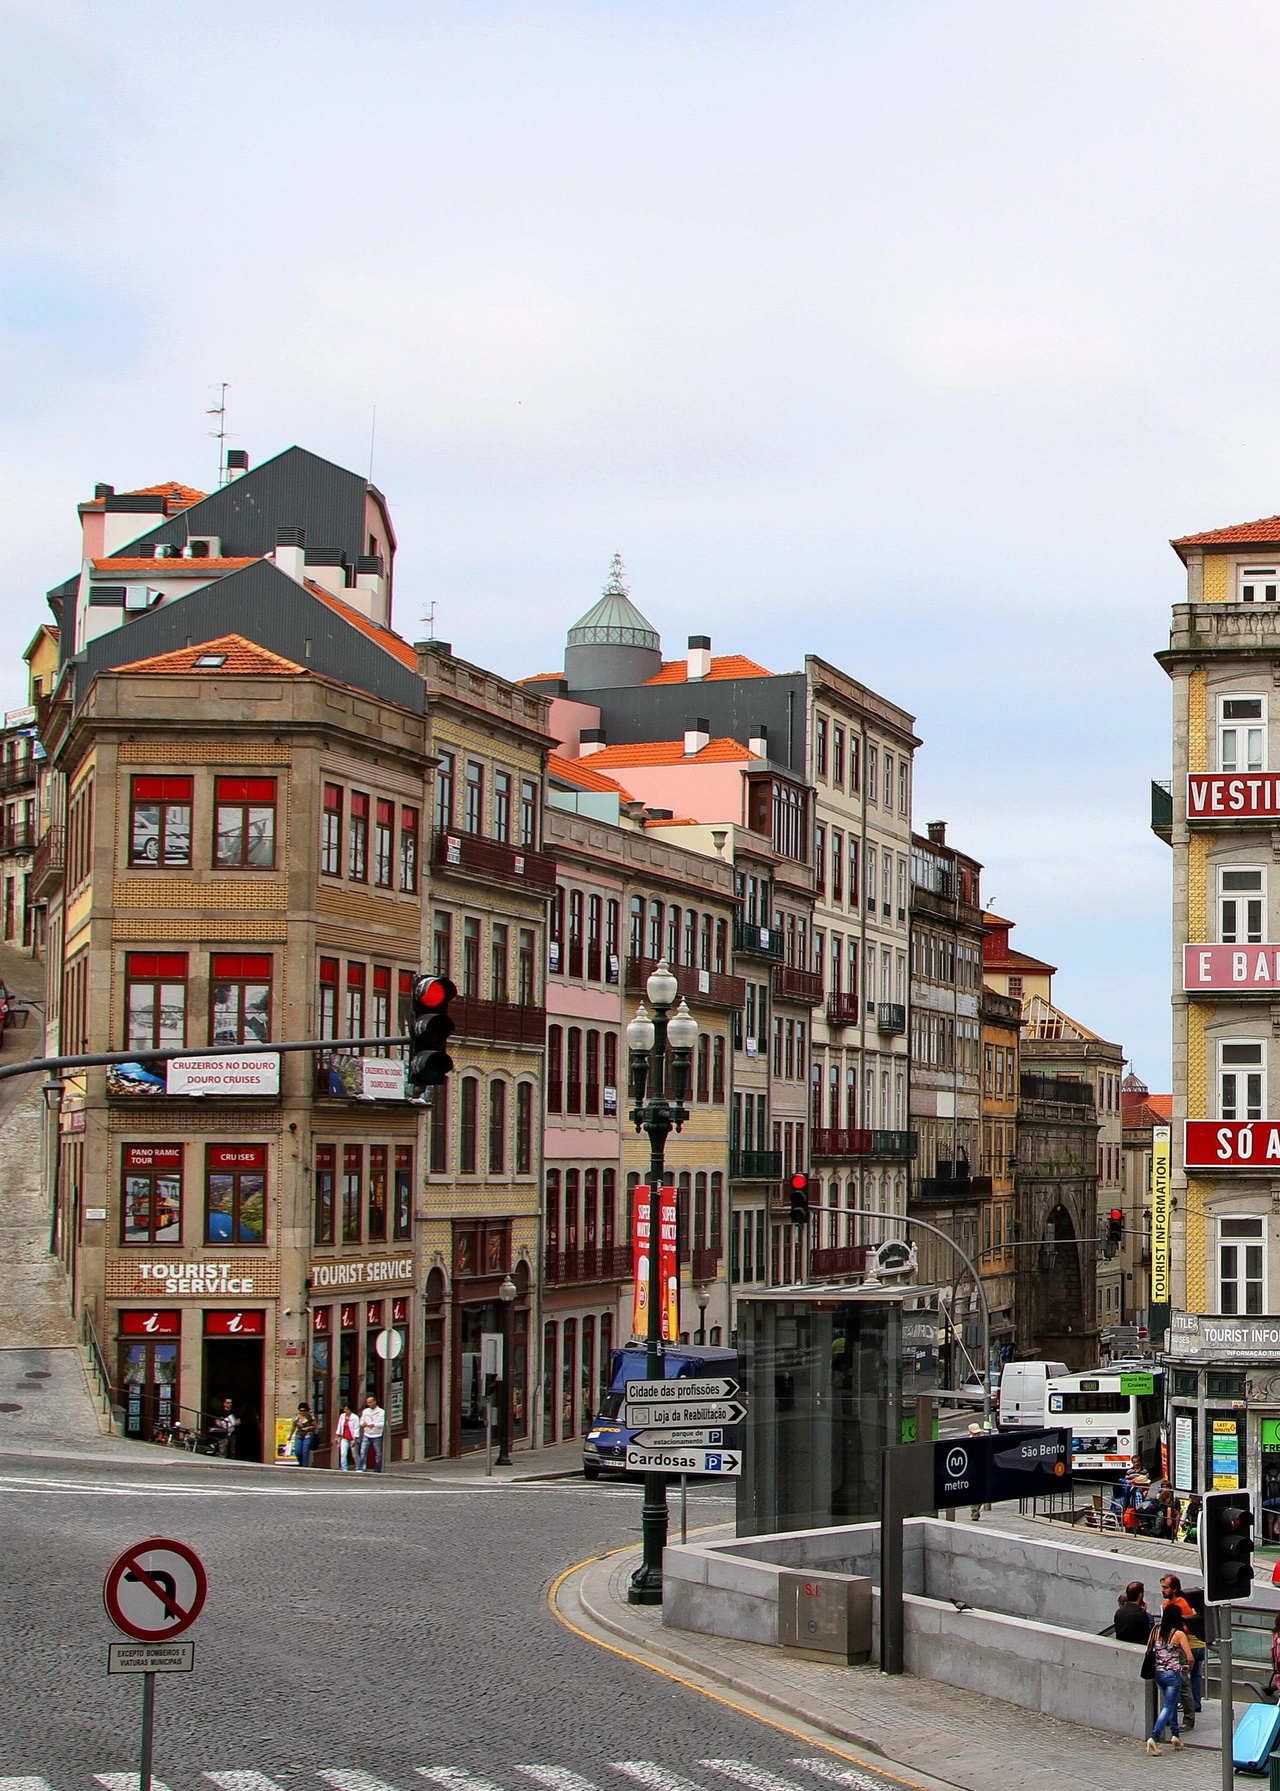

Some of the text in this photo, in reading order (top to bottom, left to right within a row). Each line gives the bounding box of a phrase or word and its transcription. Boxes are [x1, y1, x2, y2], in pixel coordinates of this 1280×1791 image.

[1199, 952, 1212, 981] E
[173, 1061, 276, 1071] CRUZEIROS NO DOURO
[187, 1075, 261, 1084] DOURO CRUISES
[1216, 1124, 1253, 1159] SÓ
[131, 1157, 153, 1165] TOUR
[1156, 1157, 1167, 1299] TOURIST INFORMATION
[139, 1264, 232, 1279] TOURIST
[312, 1260, 412, 1286] TOURIST SERVICE
[165, 1279, 254, 1293] SERVICE
[1204, 1329, 1249, 1343] TOURIST
[630, 1384, 720, 1399] Cidade das profissões
[654, 1407, 727, 1424] Loja da Reabilitação
[672, 1431, 693, 1439] parque
[1021, 1443, 1065, 1457] São Bento
[628, 1452, 696, 1467] Cardosas
[944, 1480, 969, 1491] metro
[117, 1650, 144, 1658] EXCEPTO
[147, 1649, 180, 1657] BOMBEIROS
[151, 1658, 182, 1666] MUNICIPAIS
